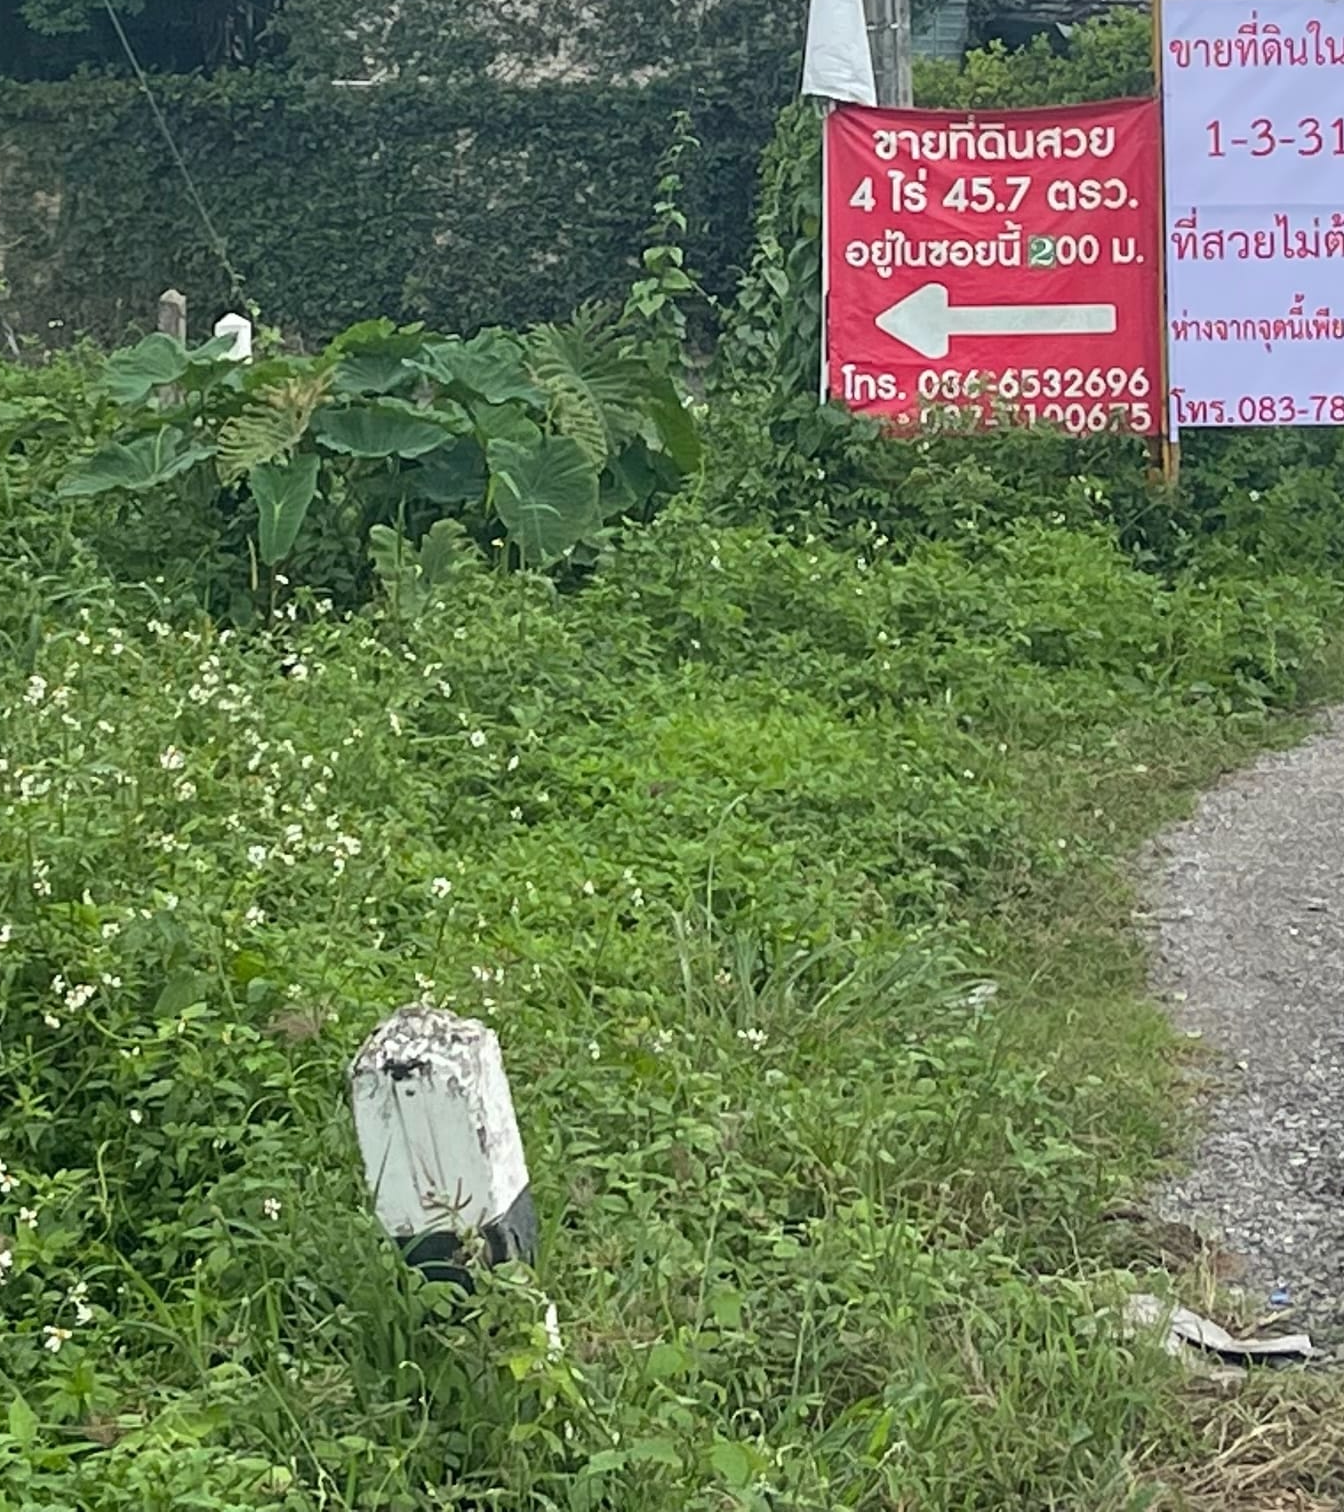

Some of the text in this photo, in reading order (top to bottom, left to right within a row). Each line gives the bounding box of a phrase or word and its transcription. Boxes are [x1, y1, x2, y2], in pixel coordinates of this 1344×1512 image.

[872, 114, 1116, 161] ขายที่ดินสวย
[848, 167, 1139, 213] 4 ไร่ 45.7 ตรว.
[844, 219, 1145, 278] อยู่ในซอยนี้ 200 ม.
[840, 363, 907, 401] โทร.
